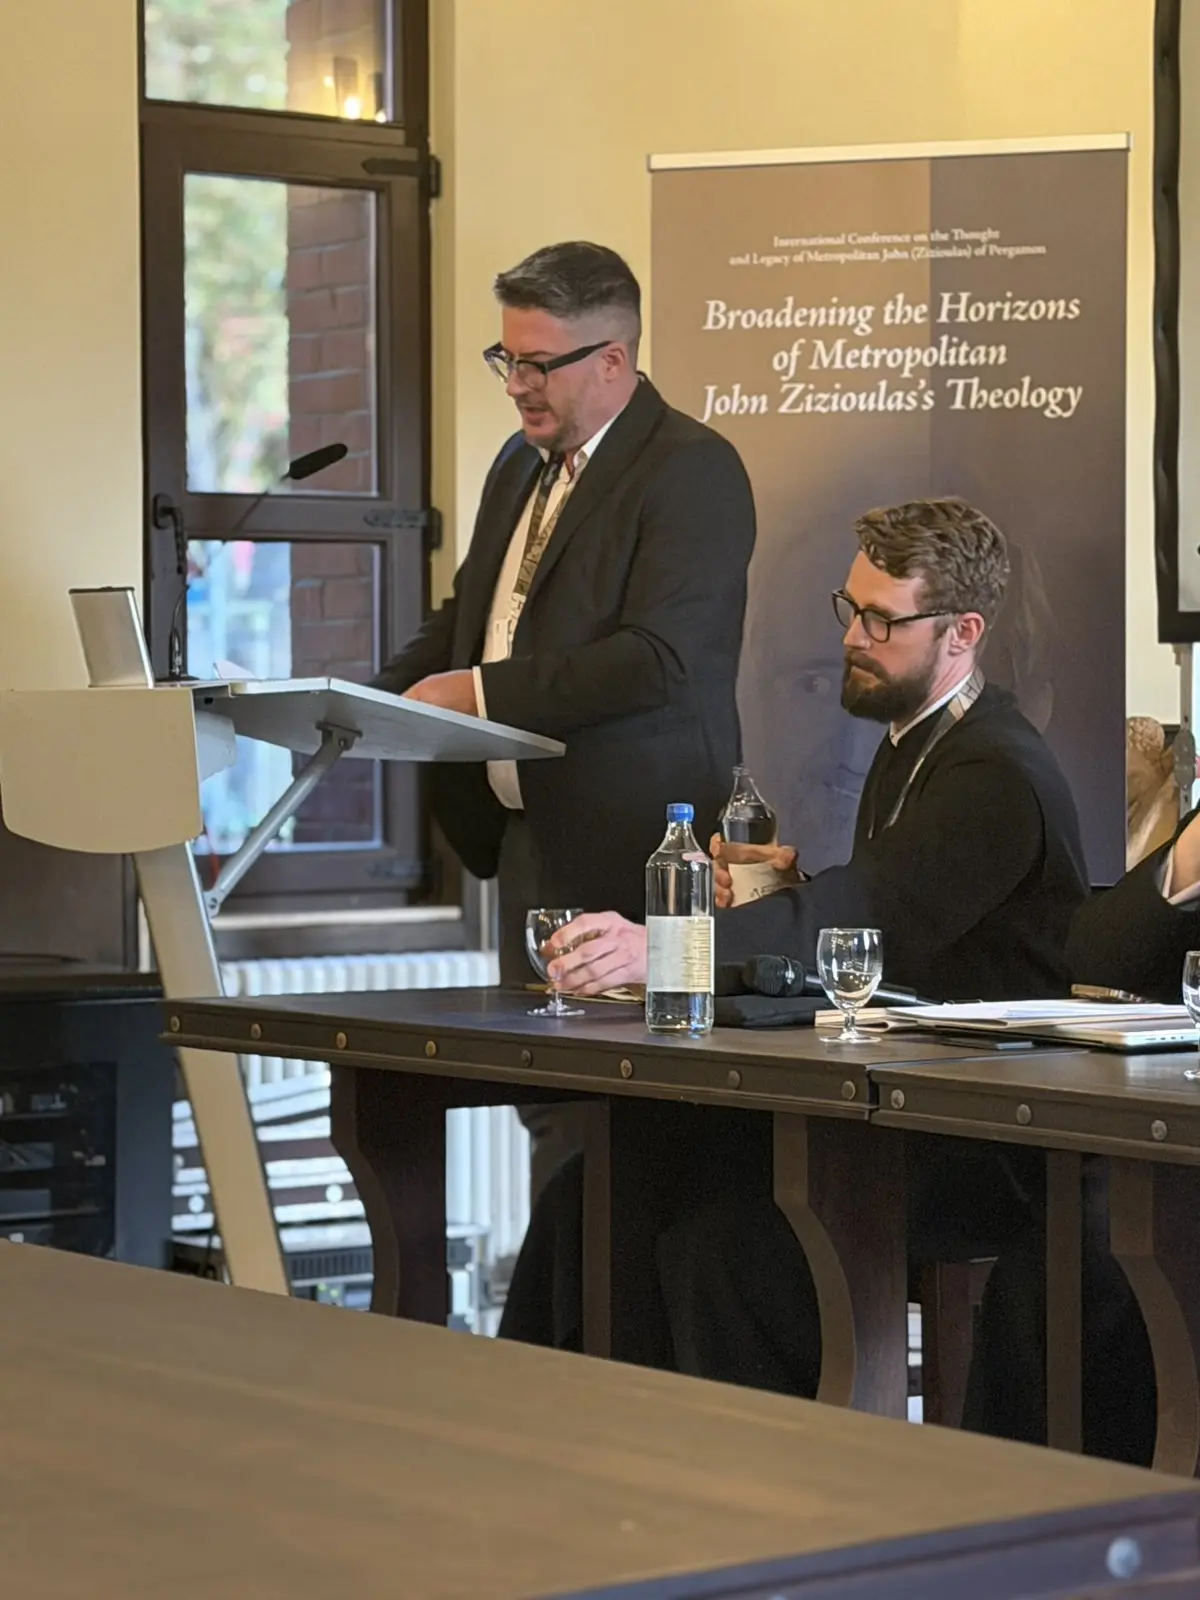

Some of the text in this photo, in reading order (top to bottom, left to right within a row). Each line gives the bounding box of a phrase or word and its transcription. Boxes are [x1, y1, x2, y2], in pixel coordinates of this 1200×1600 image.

[728, 244, 1047, 267] and Legacy of Metropolitan John (Zizioulas) of Pergamon
[773, 227, 1000, 248] International Conference on the Thought
[702, 291, 1081, 336] Broadening the Horizons
[772, 335, 1008, 380] of Metropolitan
[699, 376, 1083, 424] John Zizioulas's Theology
